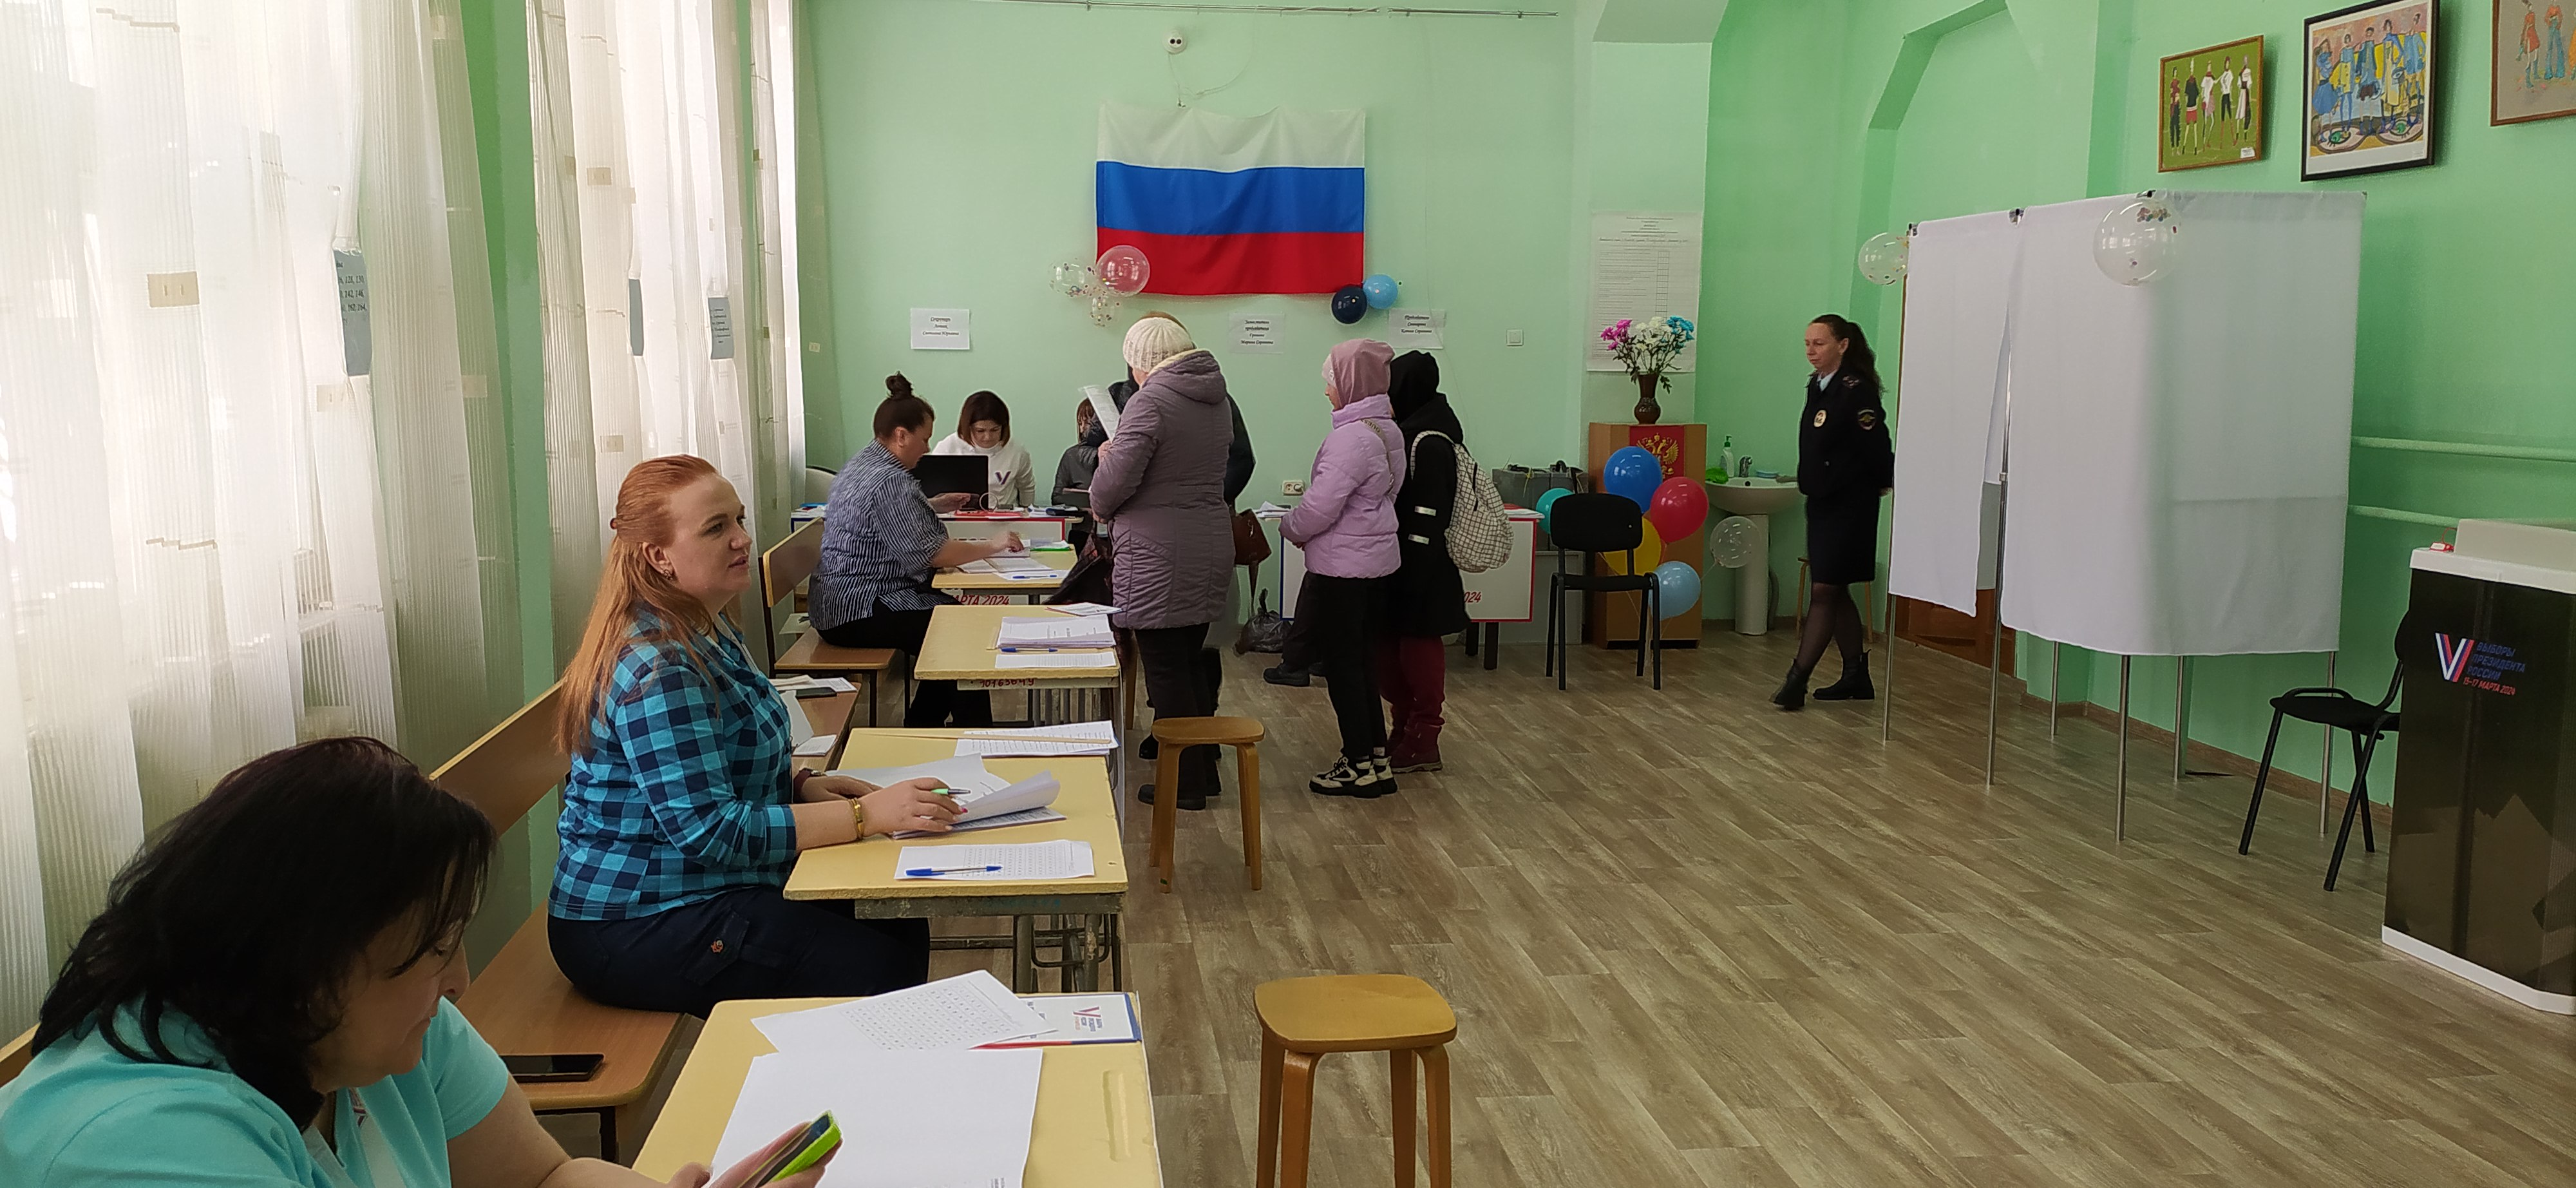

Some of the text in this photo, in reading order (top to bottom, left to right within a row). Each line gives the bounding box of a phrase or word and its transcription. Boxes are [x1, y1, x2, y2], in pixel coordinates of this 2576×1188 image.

[981, 594, 1010, 606] 2024
[1463, 591, 1482, 604] 024
[2477, 642, 2515, 656] ВЫБОРЫ
[2472, 654, 2525, 672] ПРЕЗИДЕНТА
[2467, 666, 2501, 680] РОССИИ
[2479, 681, 2499, 691] МАРТА
[2500, 686, 2515, 695] 2024
